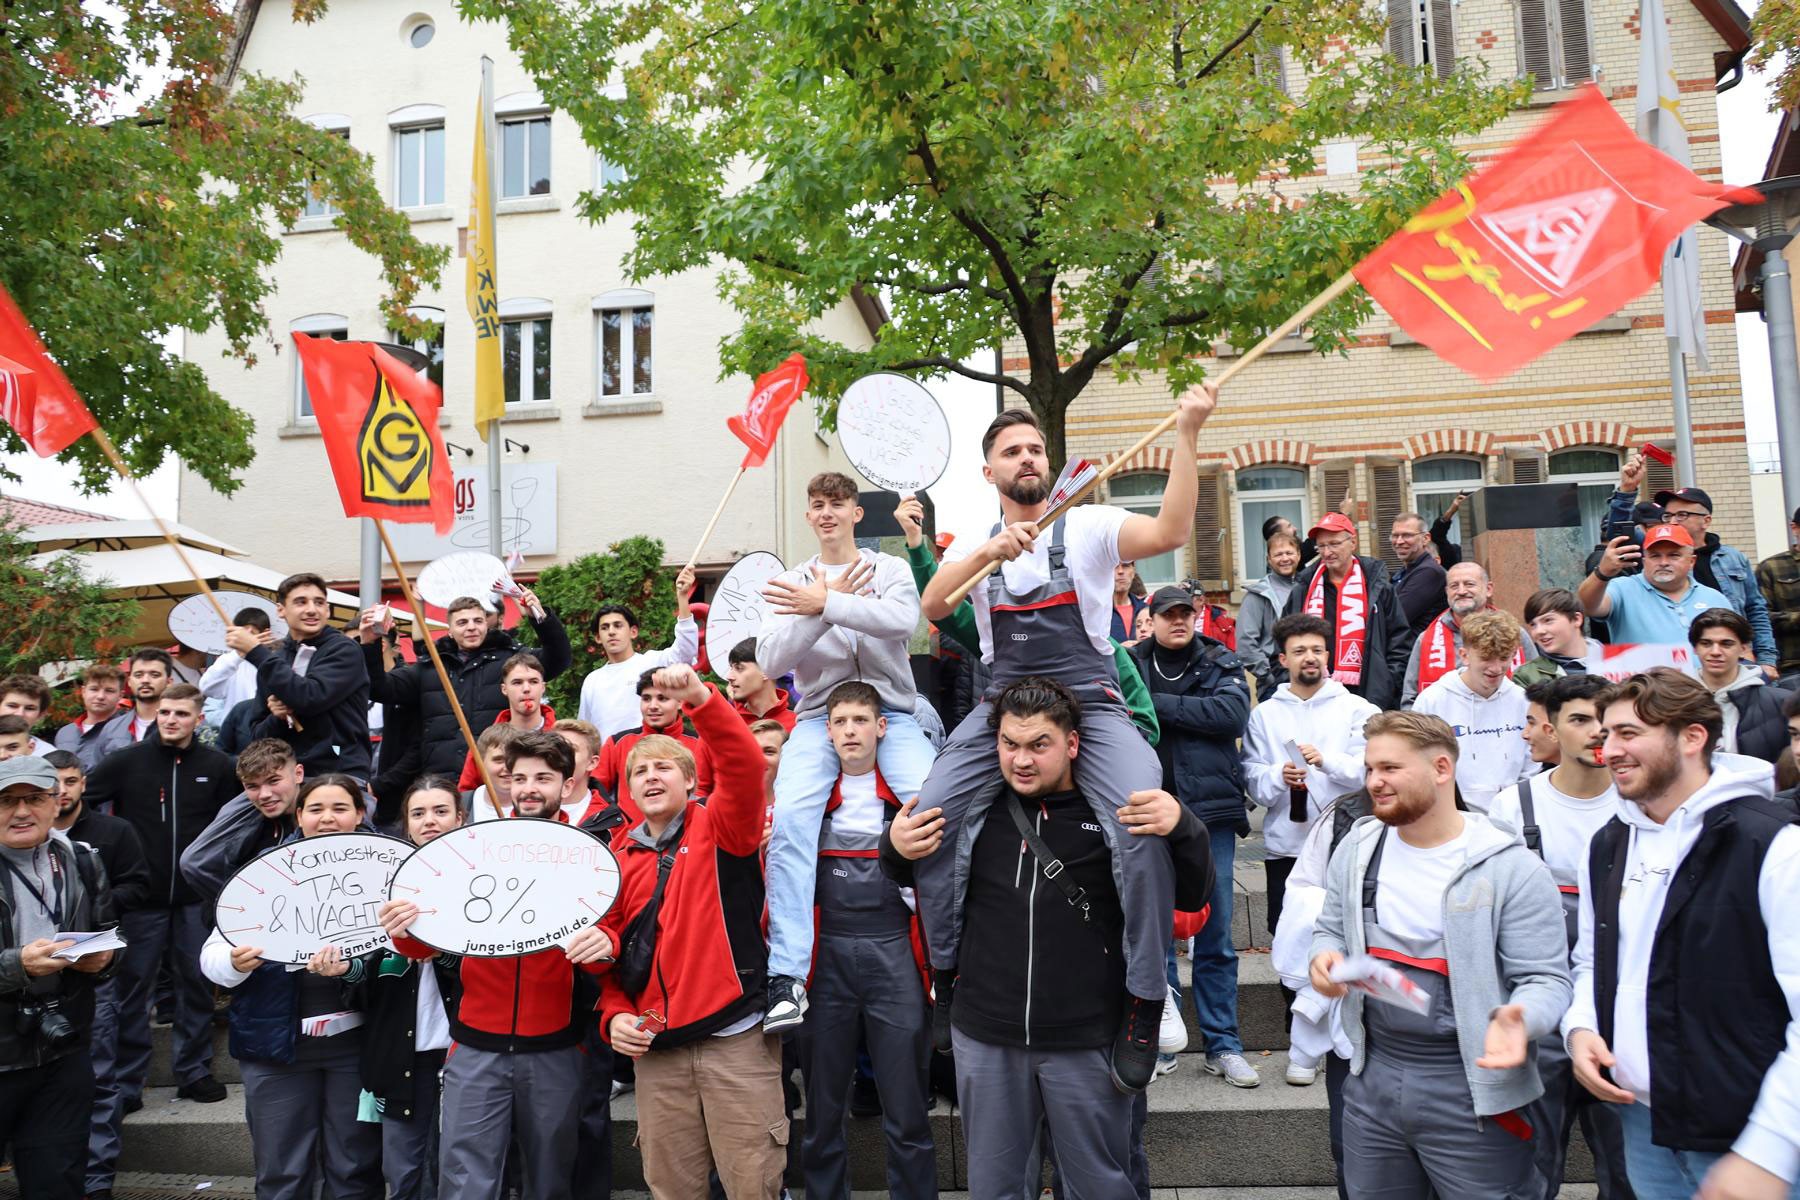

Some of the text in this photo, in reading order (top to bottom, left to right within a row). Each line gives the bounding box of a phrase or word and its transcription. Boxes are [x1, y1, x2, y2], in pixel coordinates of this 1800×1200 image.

[1403, 181, 1588, 329] Jugend!
[856, 459, 920, 490] junge-igmetall.de
[712, 576, 755, 622] WIR
[482, 838, 601, 871] Konsequent
[297, 872, 365, 901] TAG
[464, 874, 537, 925] 8%
[269, 894, 287, 933] &
[463, 916, 590, 954] junge-igmetall.de
